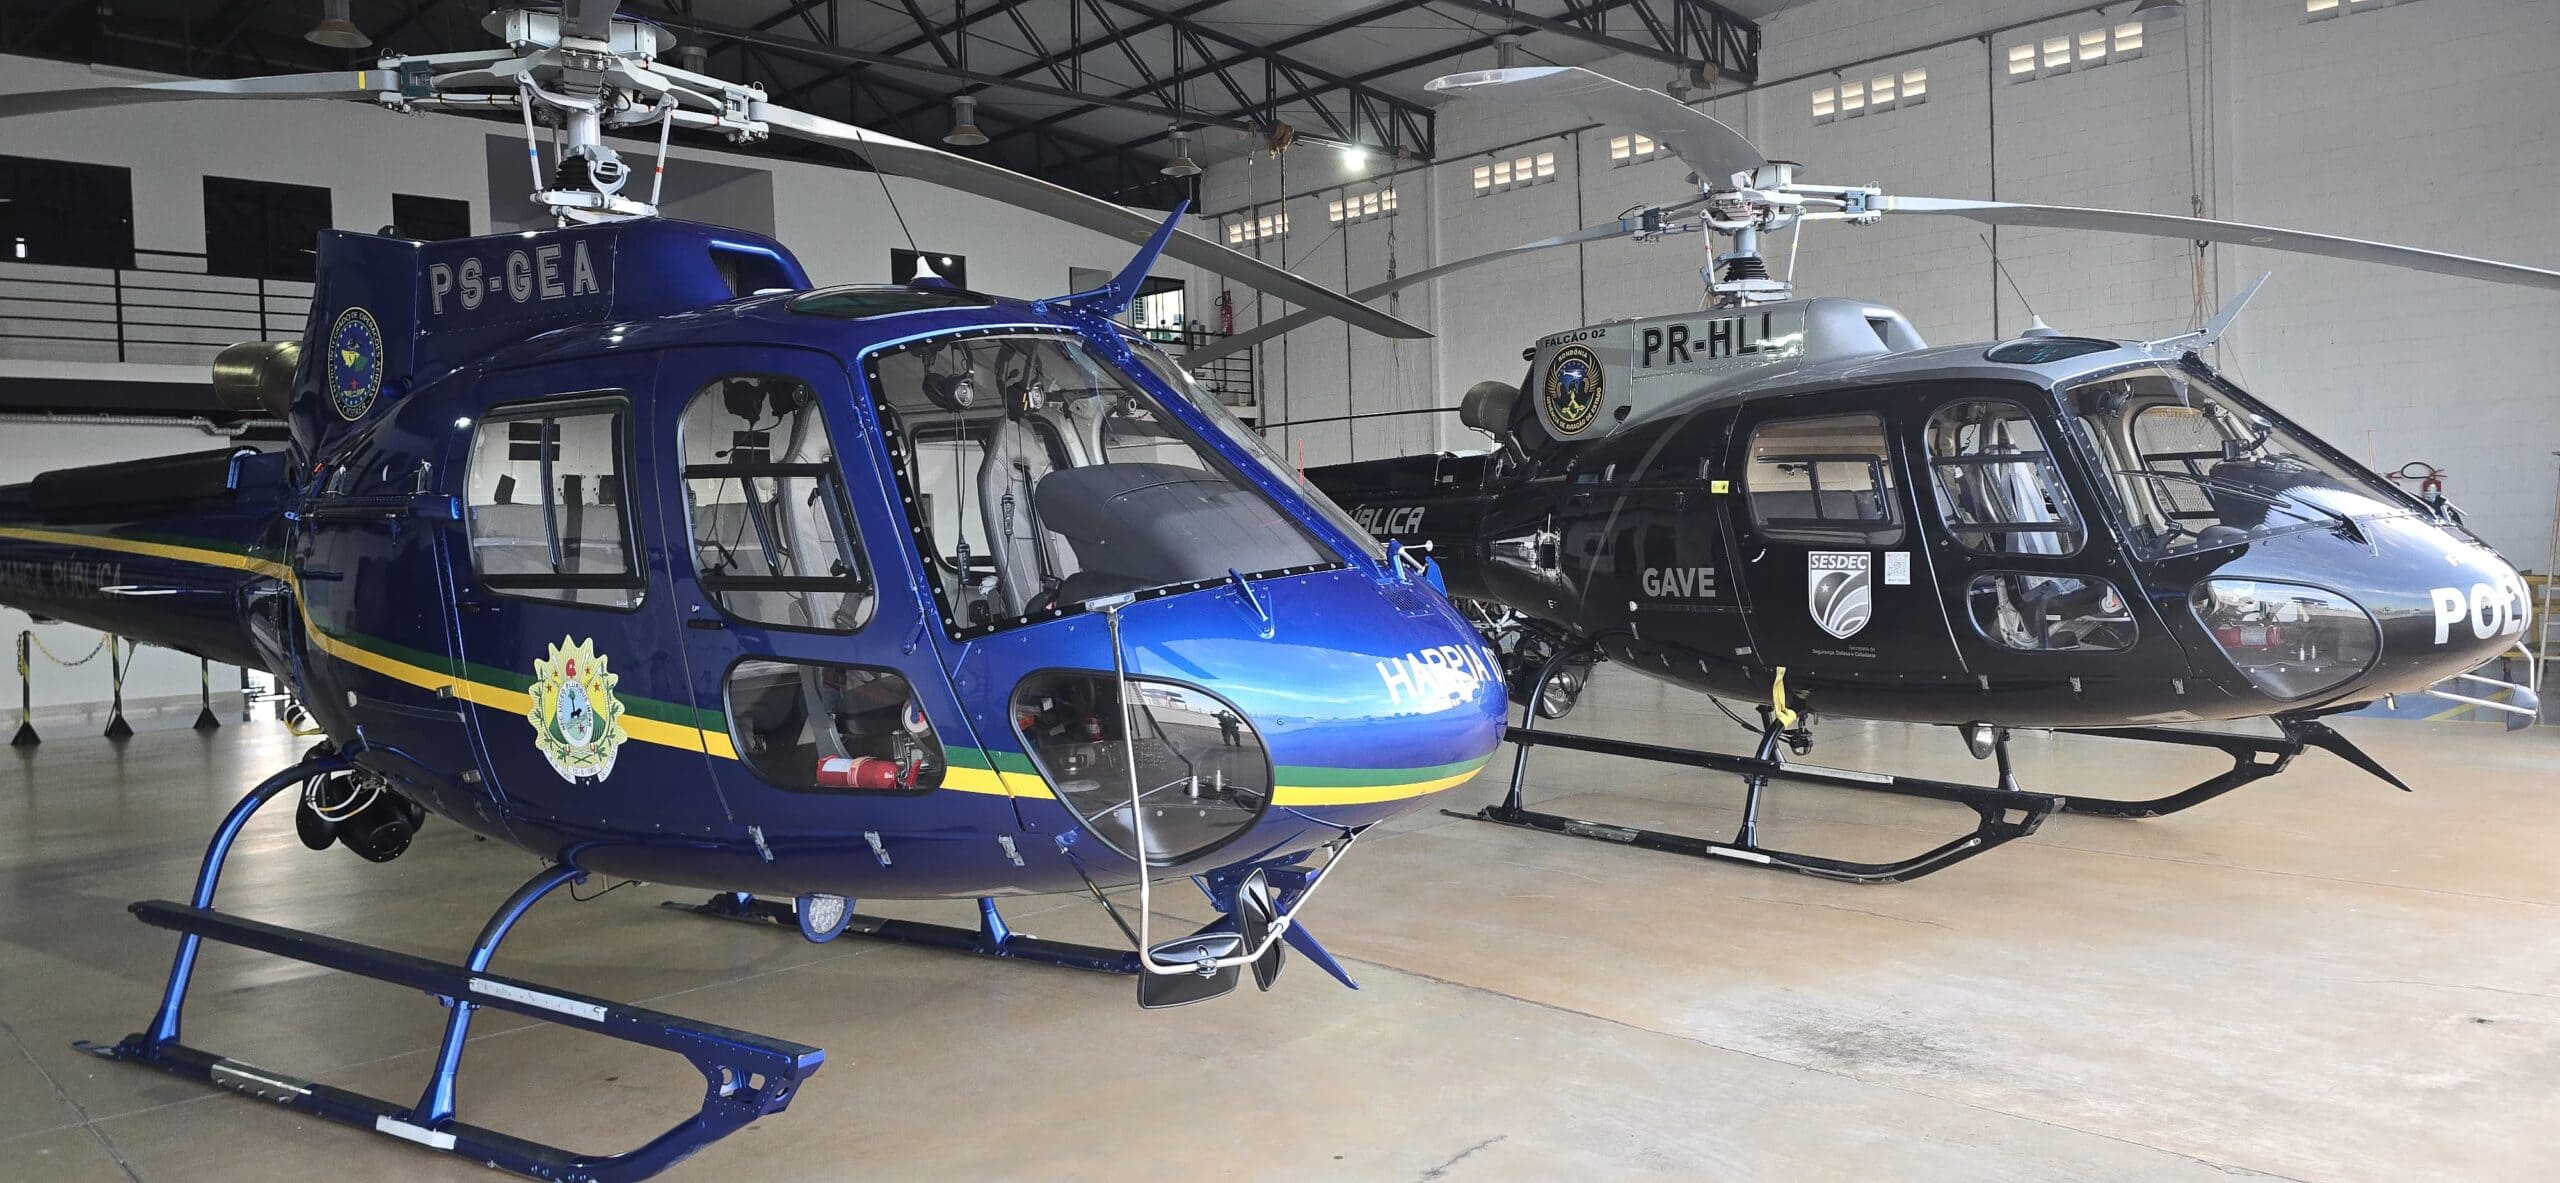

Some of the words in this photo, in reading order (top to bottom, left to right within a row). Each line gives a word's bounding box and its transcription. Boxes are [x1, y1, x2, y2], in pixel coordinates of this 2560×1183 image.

[429, 239, 600, 316] PS-GEA
[1545, 331, 1588, 348] FALCÃO
[1591, 328, 1606, 339] 02
[1642, 311, 1784, 369] PR-HLL
[1811, 555, 1868, 570] SESDEC
[1642, 567, 1716, 598] GAVE
